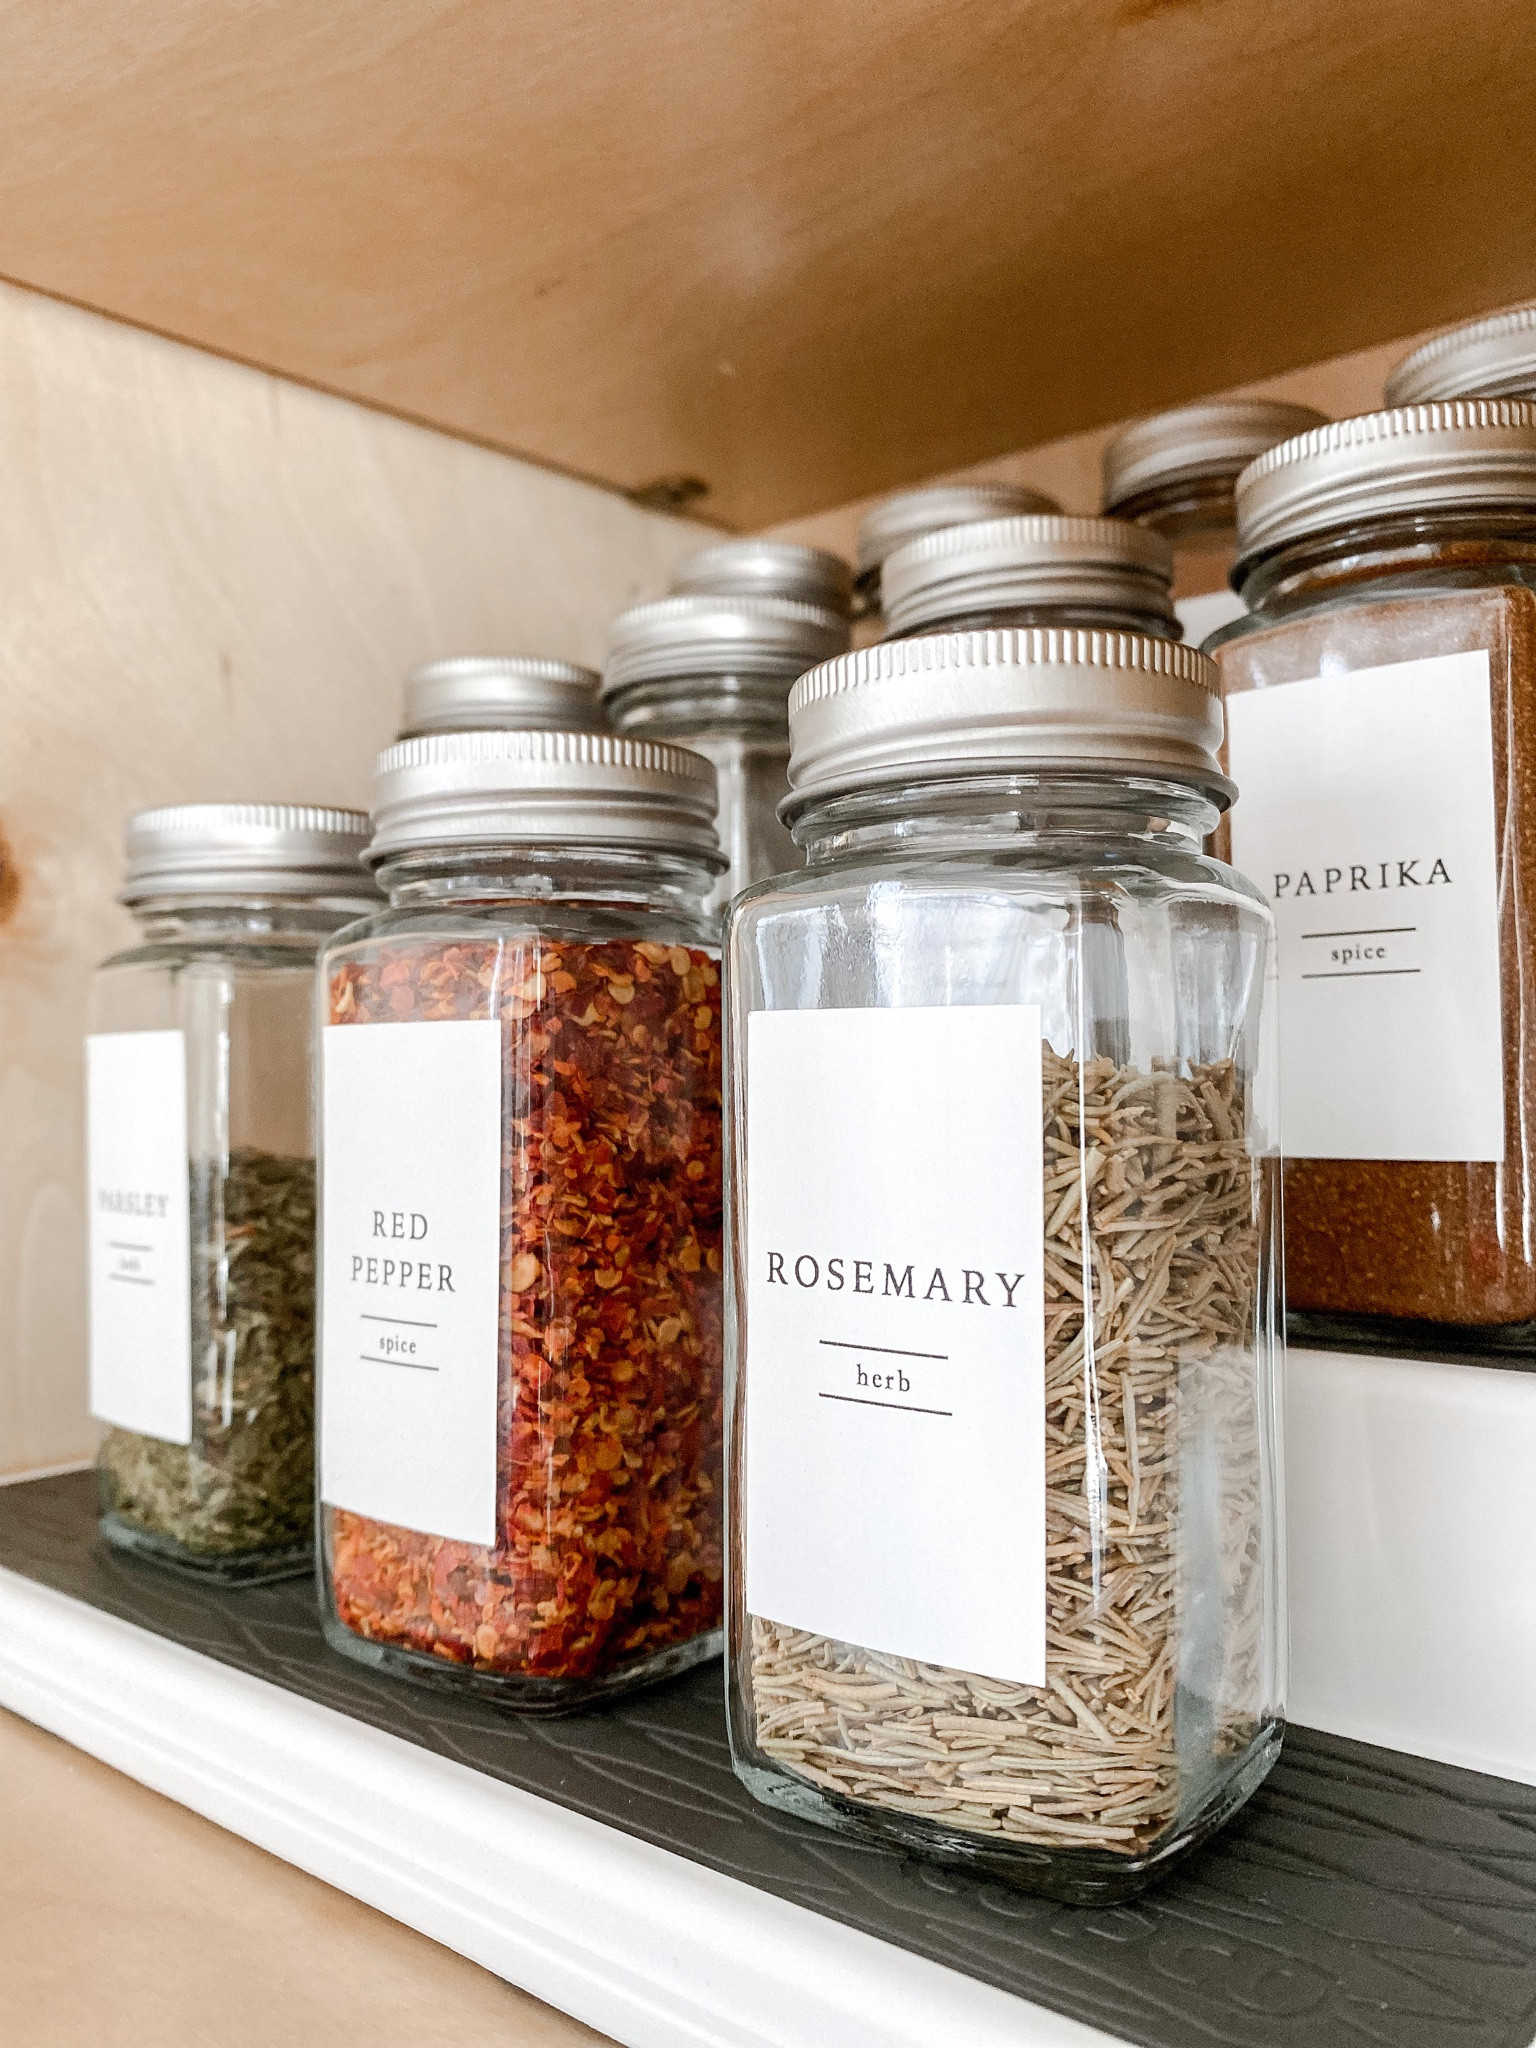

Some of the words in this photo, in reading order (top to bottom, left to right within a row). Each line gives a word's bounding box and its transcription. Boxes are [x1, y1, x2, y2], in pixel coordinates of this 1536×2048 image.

[1274, 858, 1453, 899] PAPRIKA
[1330, 943, 1387, 965] spice
[372, 1211, 429, 1240] RED
[351, 1256, 456, 1293] PEPPER
[766, 1251, 1026, 1309] ROSEMARY
[378, 1332, 417, 1356] spice
[856, 1362, 912, 1393] herb
